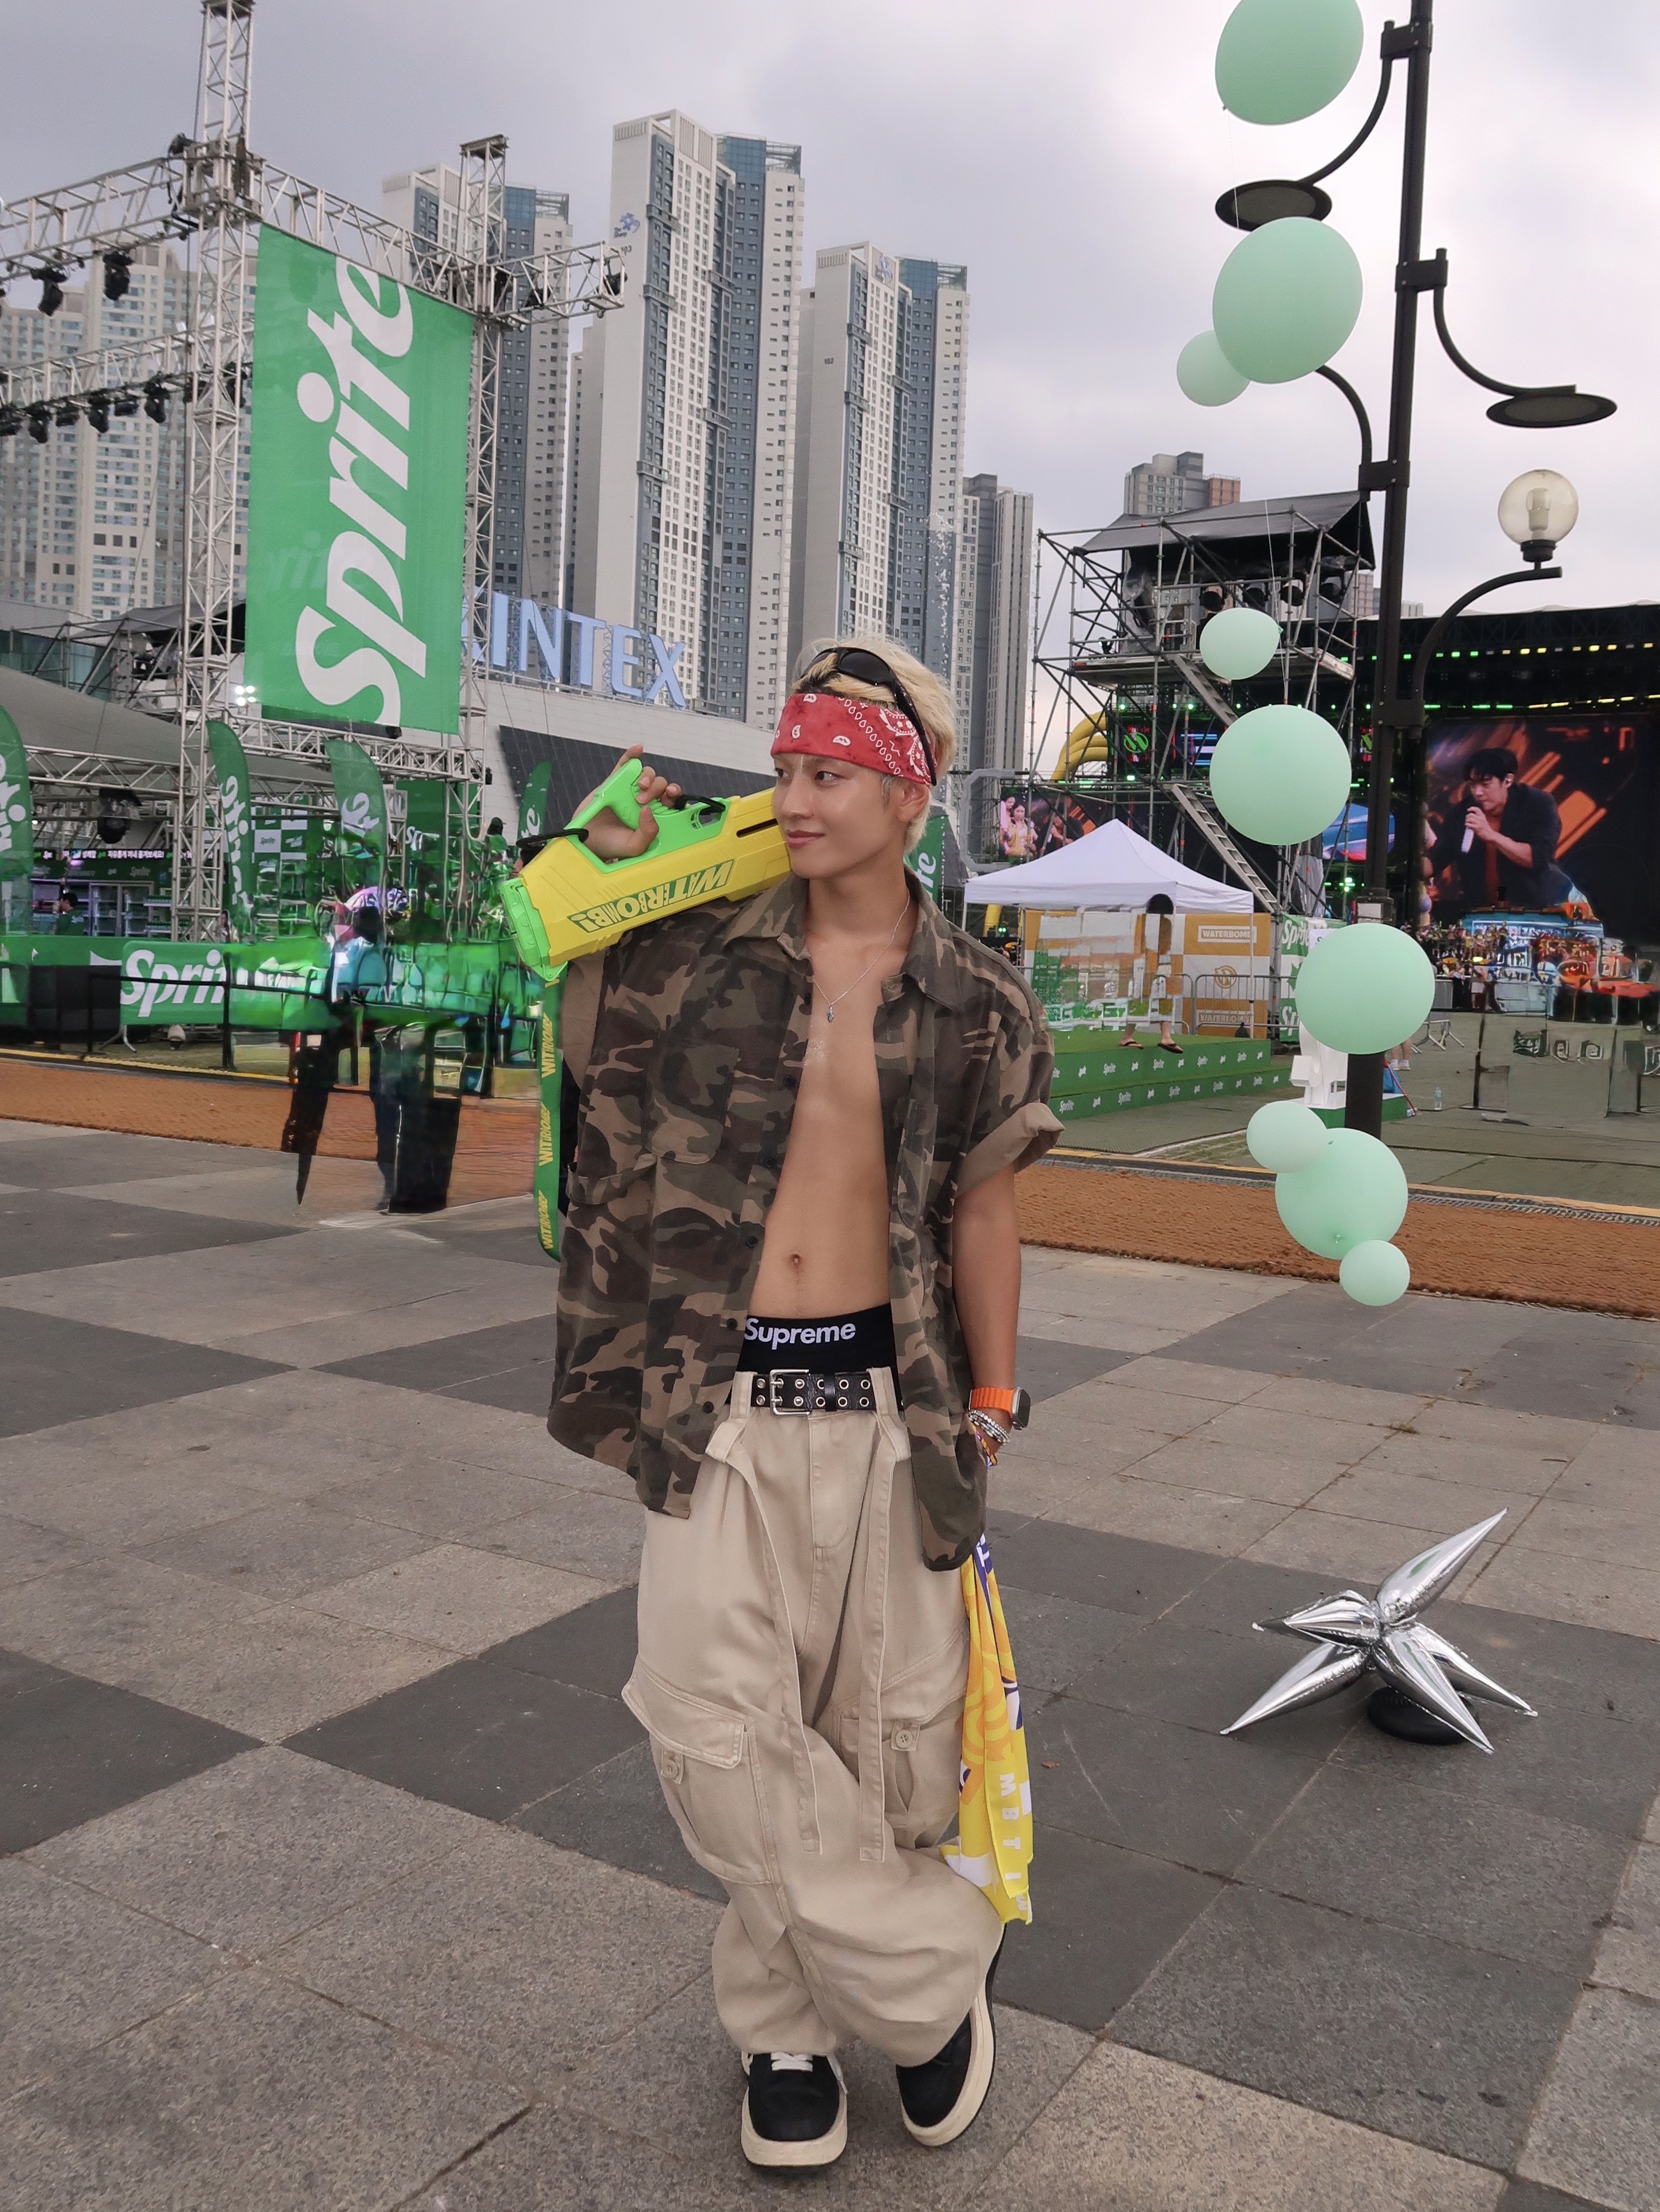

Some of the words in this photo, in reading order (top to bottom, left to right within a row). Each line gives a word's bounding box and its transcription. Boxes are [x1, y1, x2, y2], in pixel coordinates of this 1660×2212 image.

[295, 255, 426, 727] Sprite
[570, 859, 733, 932] WATERBOMB!
[120, 949, 226, 1017] Spri
[1059, 1100, 1074, 1114] Sprite
[744, 1317, 856, 1350] Supreme
